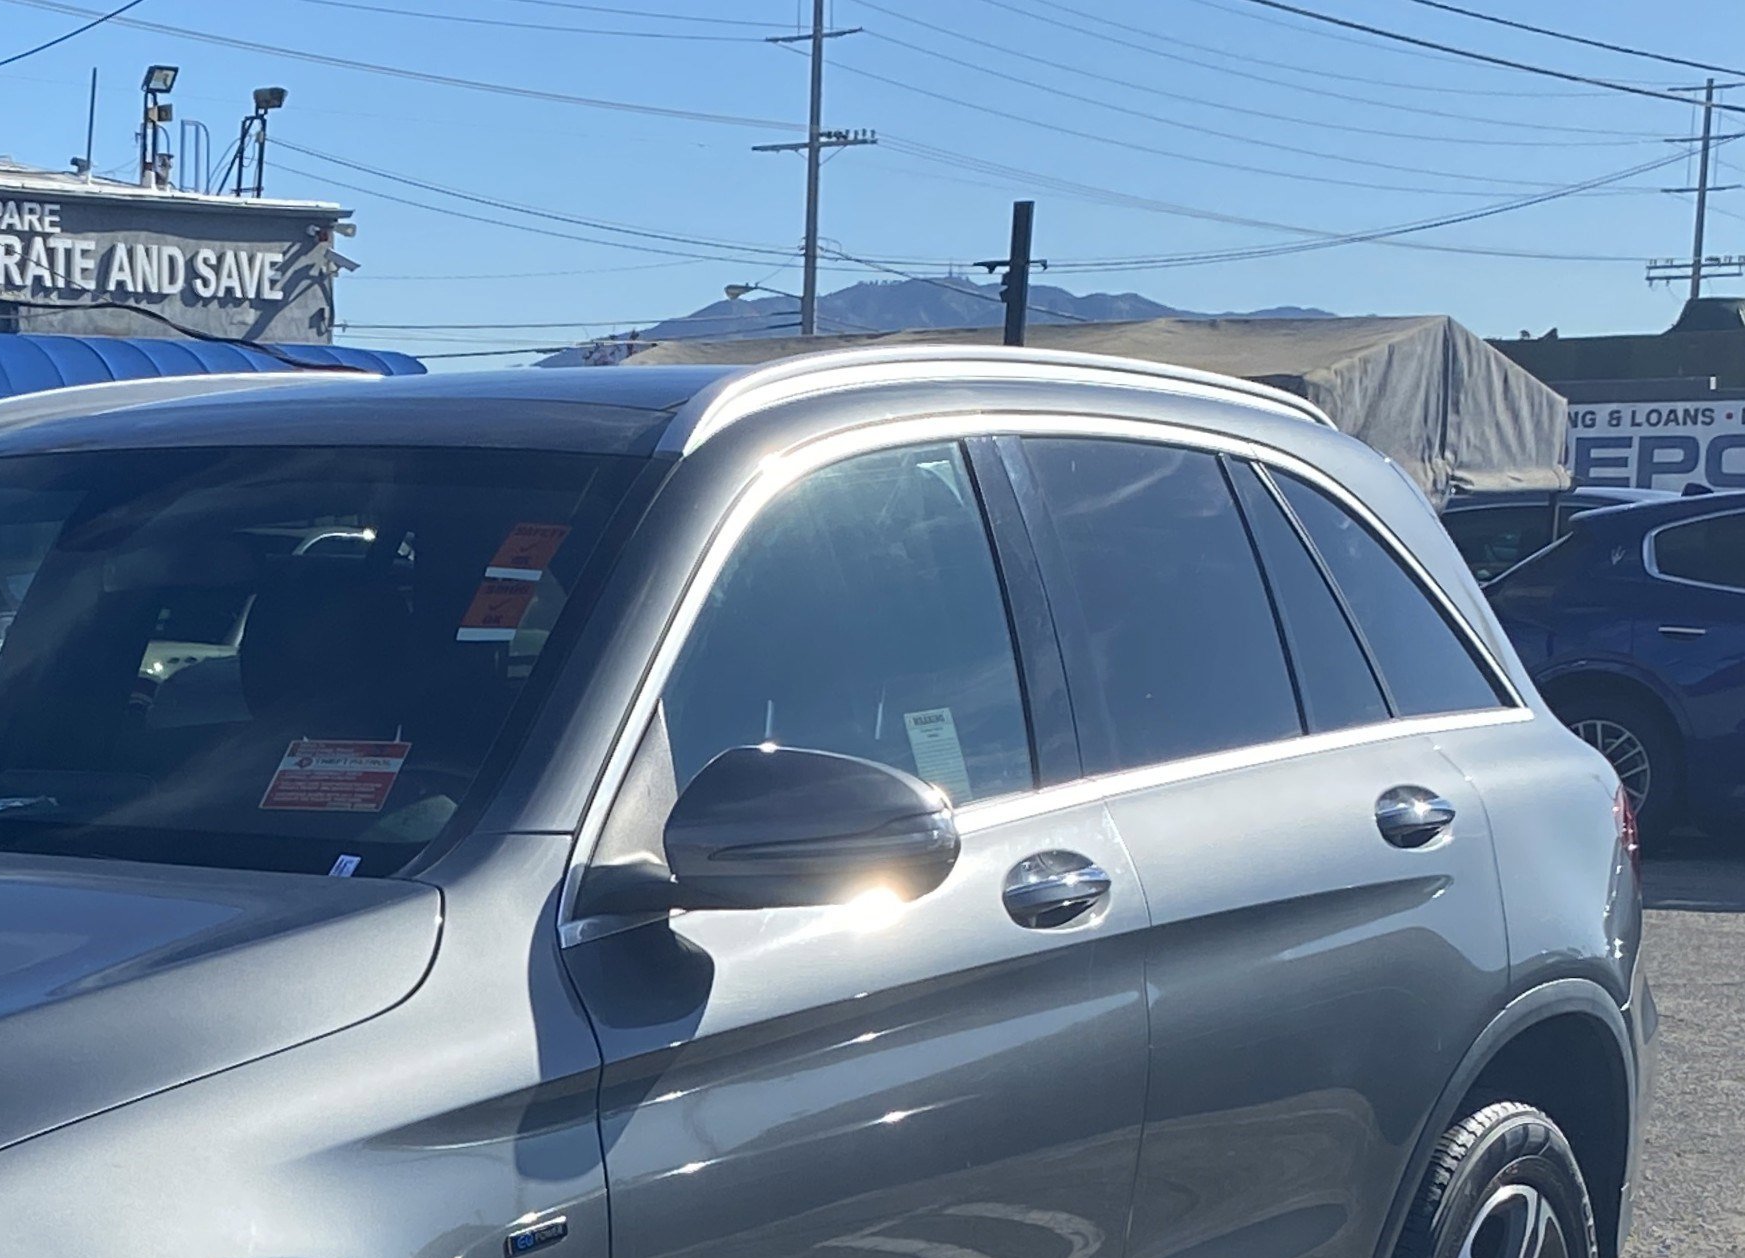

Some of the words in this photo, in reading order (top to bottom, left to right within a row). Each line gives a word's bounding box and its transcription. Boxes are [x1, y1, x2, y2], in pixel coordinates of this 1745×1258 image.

[108, 242, 186, 294] AND
[192, 248, 284, 300] SAVE
[1630, 407, 1716, 428] LOANS
